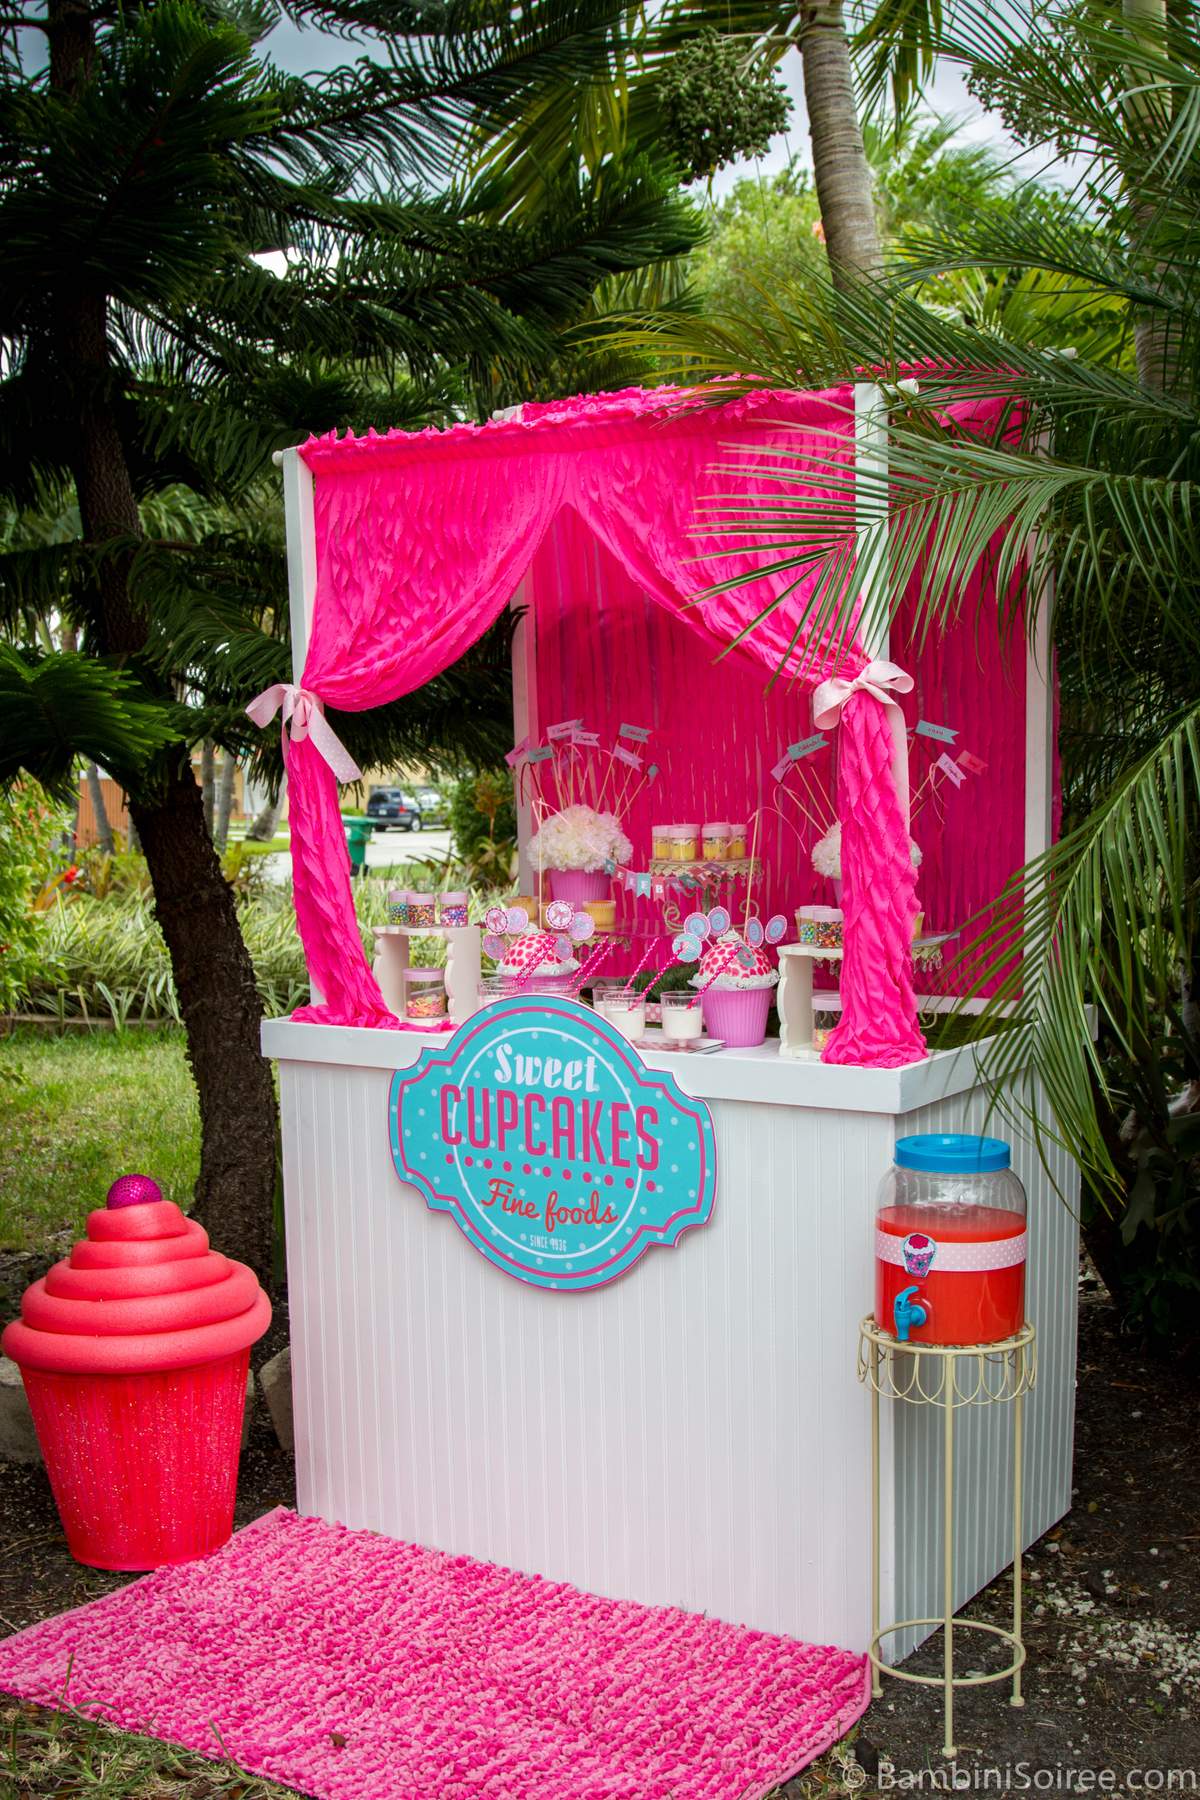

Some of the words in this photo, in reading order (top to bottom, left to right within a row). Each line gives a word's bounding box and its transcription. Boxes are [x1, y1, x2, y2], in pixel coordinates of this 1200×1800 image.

[494, 1043, 600, 1093] Sweet
[440, 1084, 660, 1171] CUPCAKES
[481, 1178, 541, 1219] Fine
[545, 1190, 619, 1232] foods
[530, 1234, 548, 1249] SINCE
